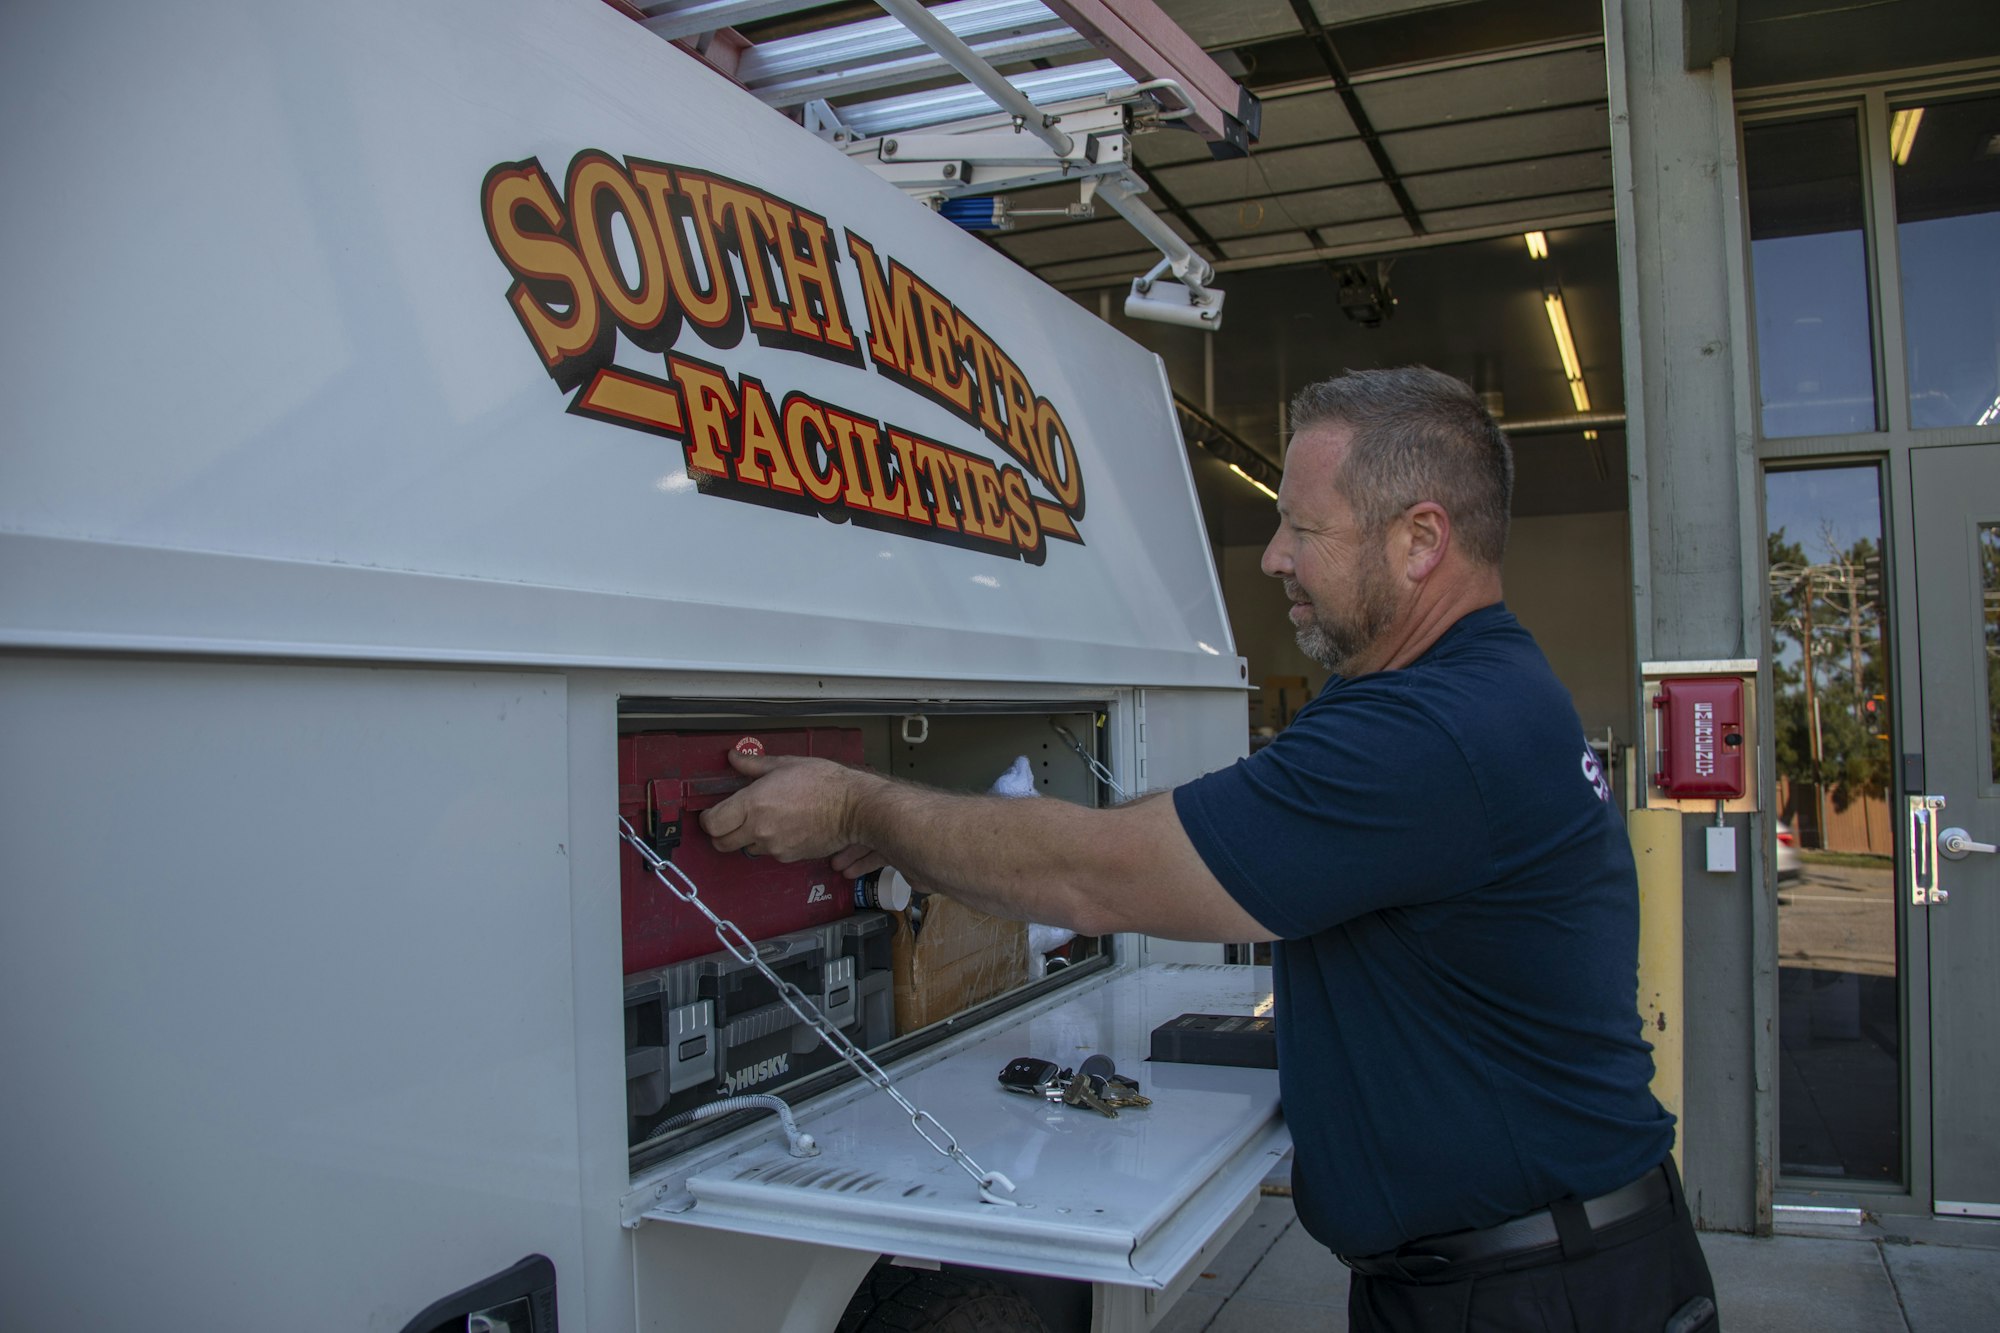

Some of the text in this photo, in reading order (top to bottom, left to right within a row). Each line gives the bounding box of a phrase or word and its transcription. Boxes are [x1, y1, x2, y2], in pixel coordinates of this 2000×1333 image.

[483, 150, 1083, 512] SOUTH METRO
[665, 352, 1042, 557] FACILITIES
[1694, 702, 1714, 777] EMERGENCY
